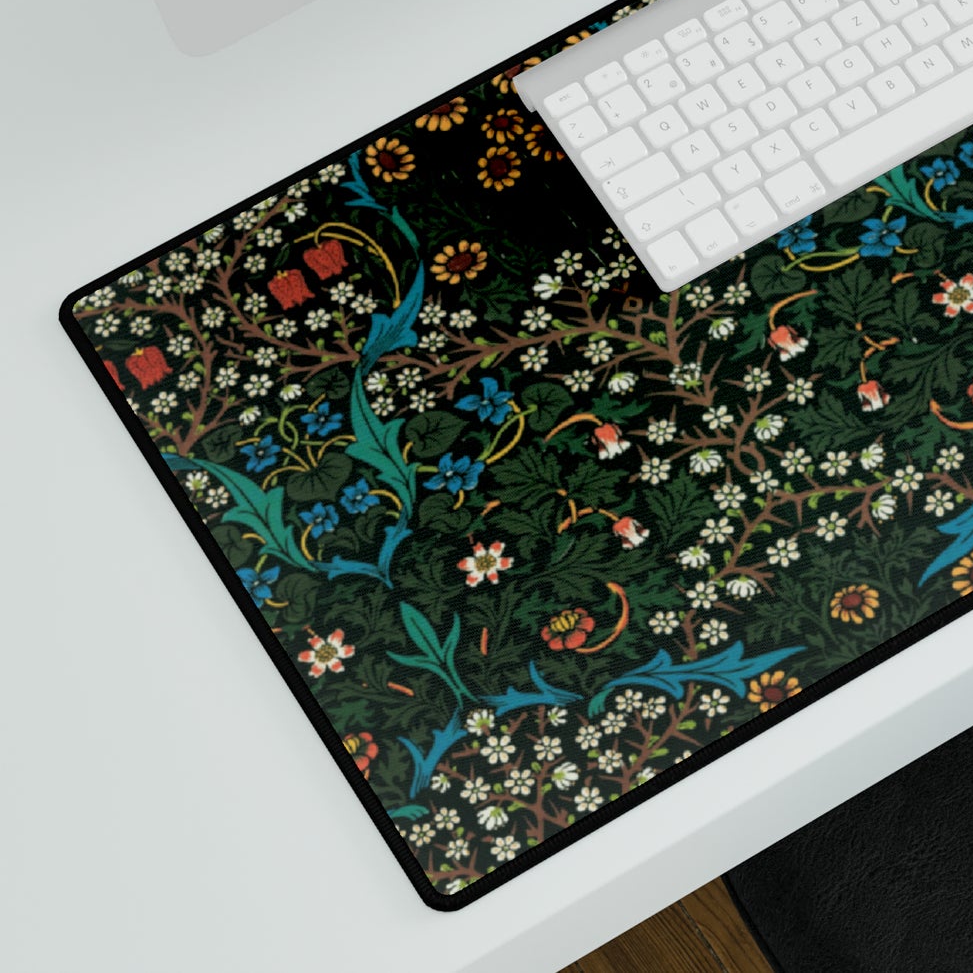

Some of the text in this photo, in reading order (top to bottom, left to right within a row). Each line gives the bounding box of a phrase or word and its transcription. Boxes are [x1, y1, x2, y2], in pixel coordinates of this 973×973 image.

[643, 79, 652, 89] 2
[682, 57, 691, 68] 3
[759, 16, 768, 26] 5
[659, 121, 671, 131] Q
[696, 99, 710, 111] W
[737, 78, 747, 89] E
[775, 58, 786, 68] R
[813, 37, 822, 46] T
[851, 15, 862, 27] Z
[690, 144, 700, 154] A
[728, 122, 738, 132] S
[765, 101, 777, 112] D
[842, 58, 854, 69] G
[880, 37, 892, 49] H
[730, 163, 740, 174] Y
[769, 142, 782, 154] X
[808, 121, 820, 132] C
[846, 99, 856, 110] V
[885, 80, 896, 90] B
[922, 58, 935, 69] N
[960, 37, 973, 49] M
